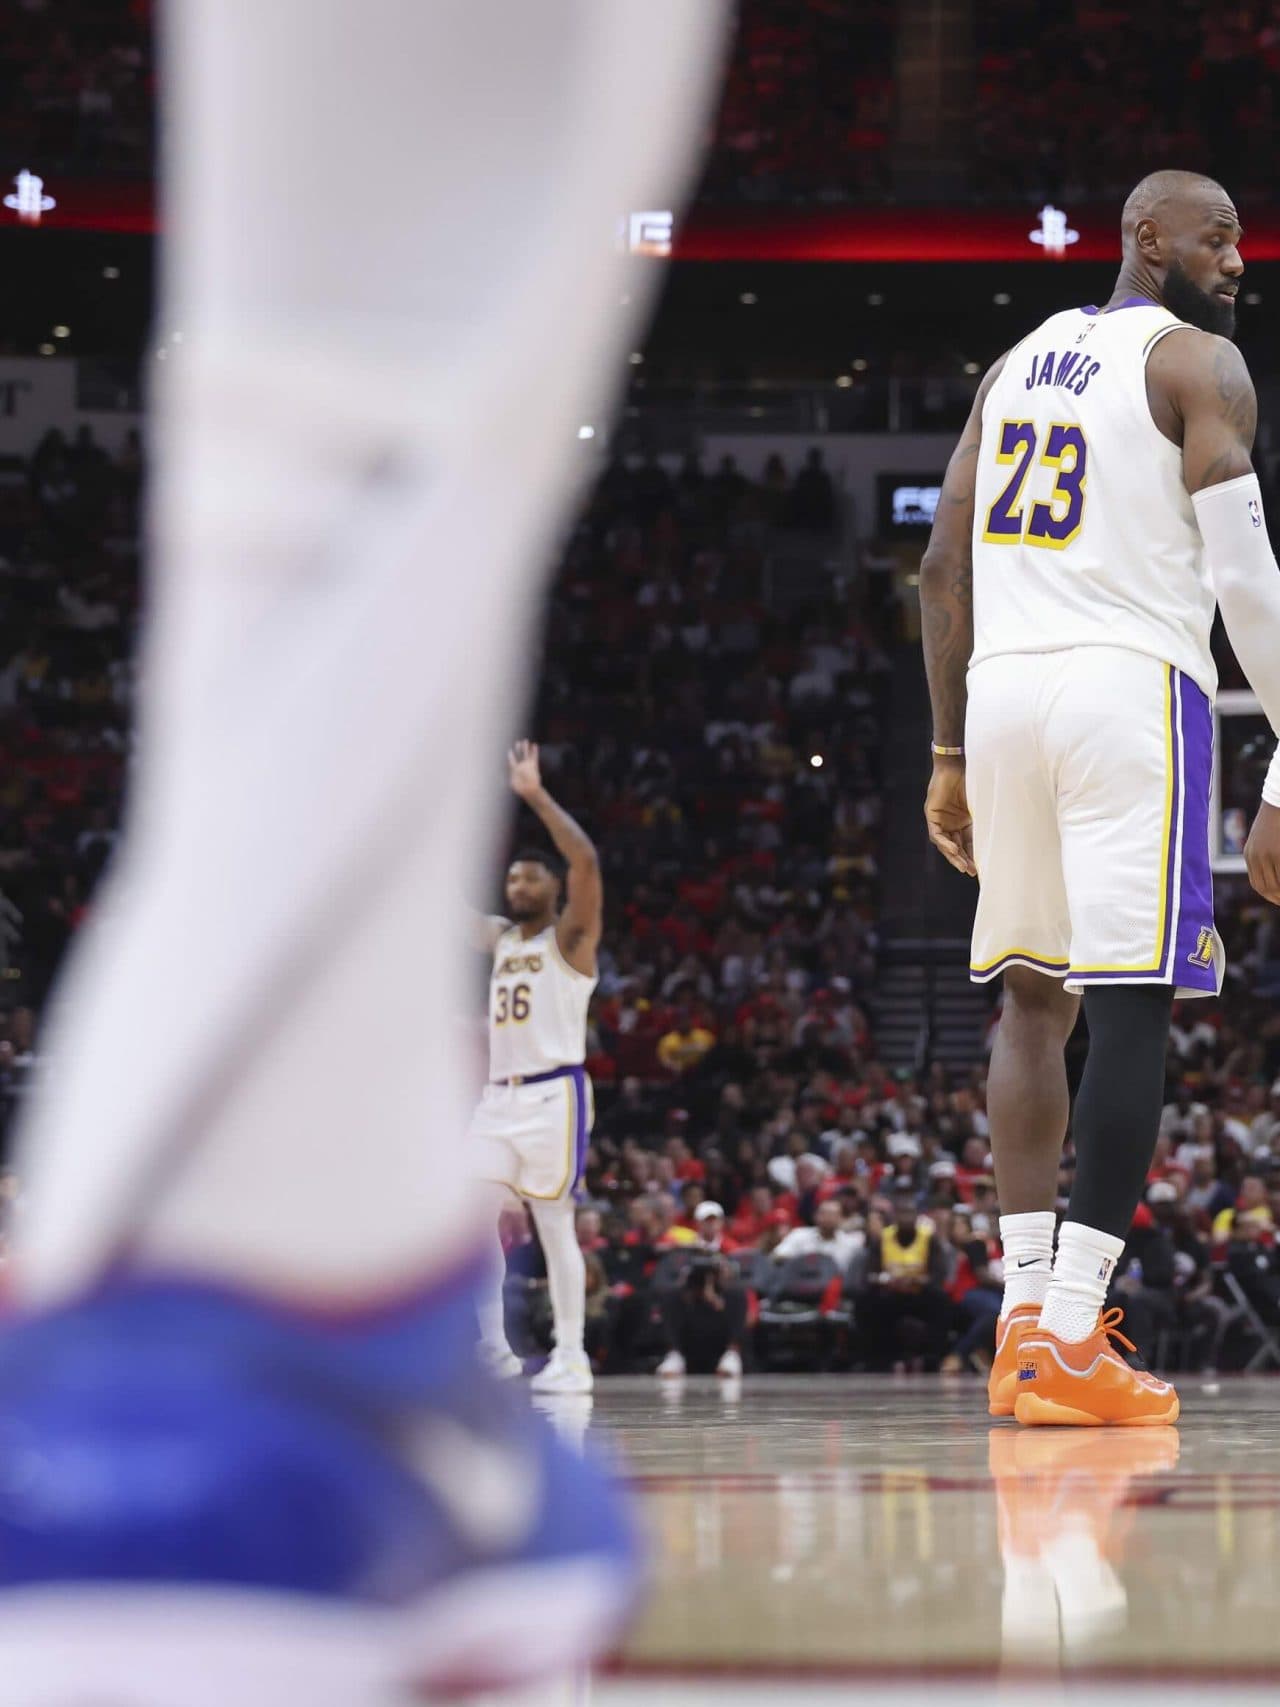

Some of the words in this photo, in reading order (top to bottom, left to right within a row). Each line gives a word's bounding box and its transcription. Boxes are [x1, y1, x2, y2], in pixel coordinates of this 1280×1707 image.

[1026, 350, 1101, 396] JAMES
[982, 418, 1088, 551] 23
[495, 983, 531, 1027] 36
